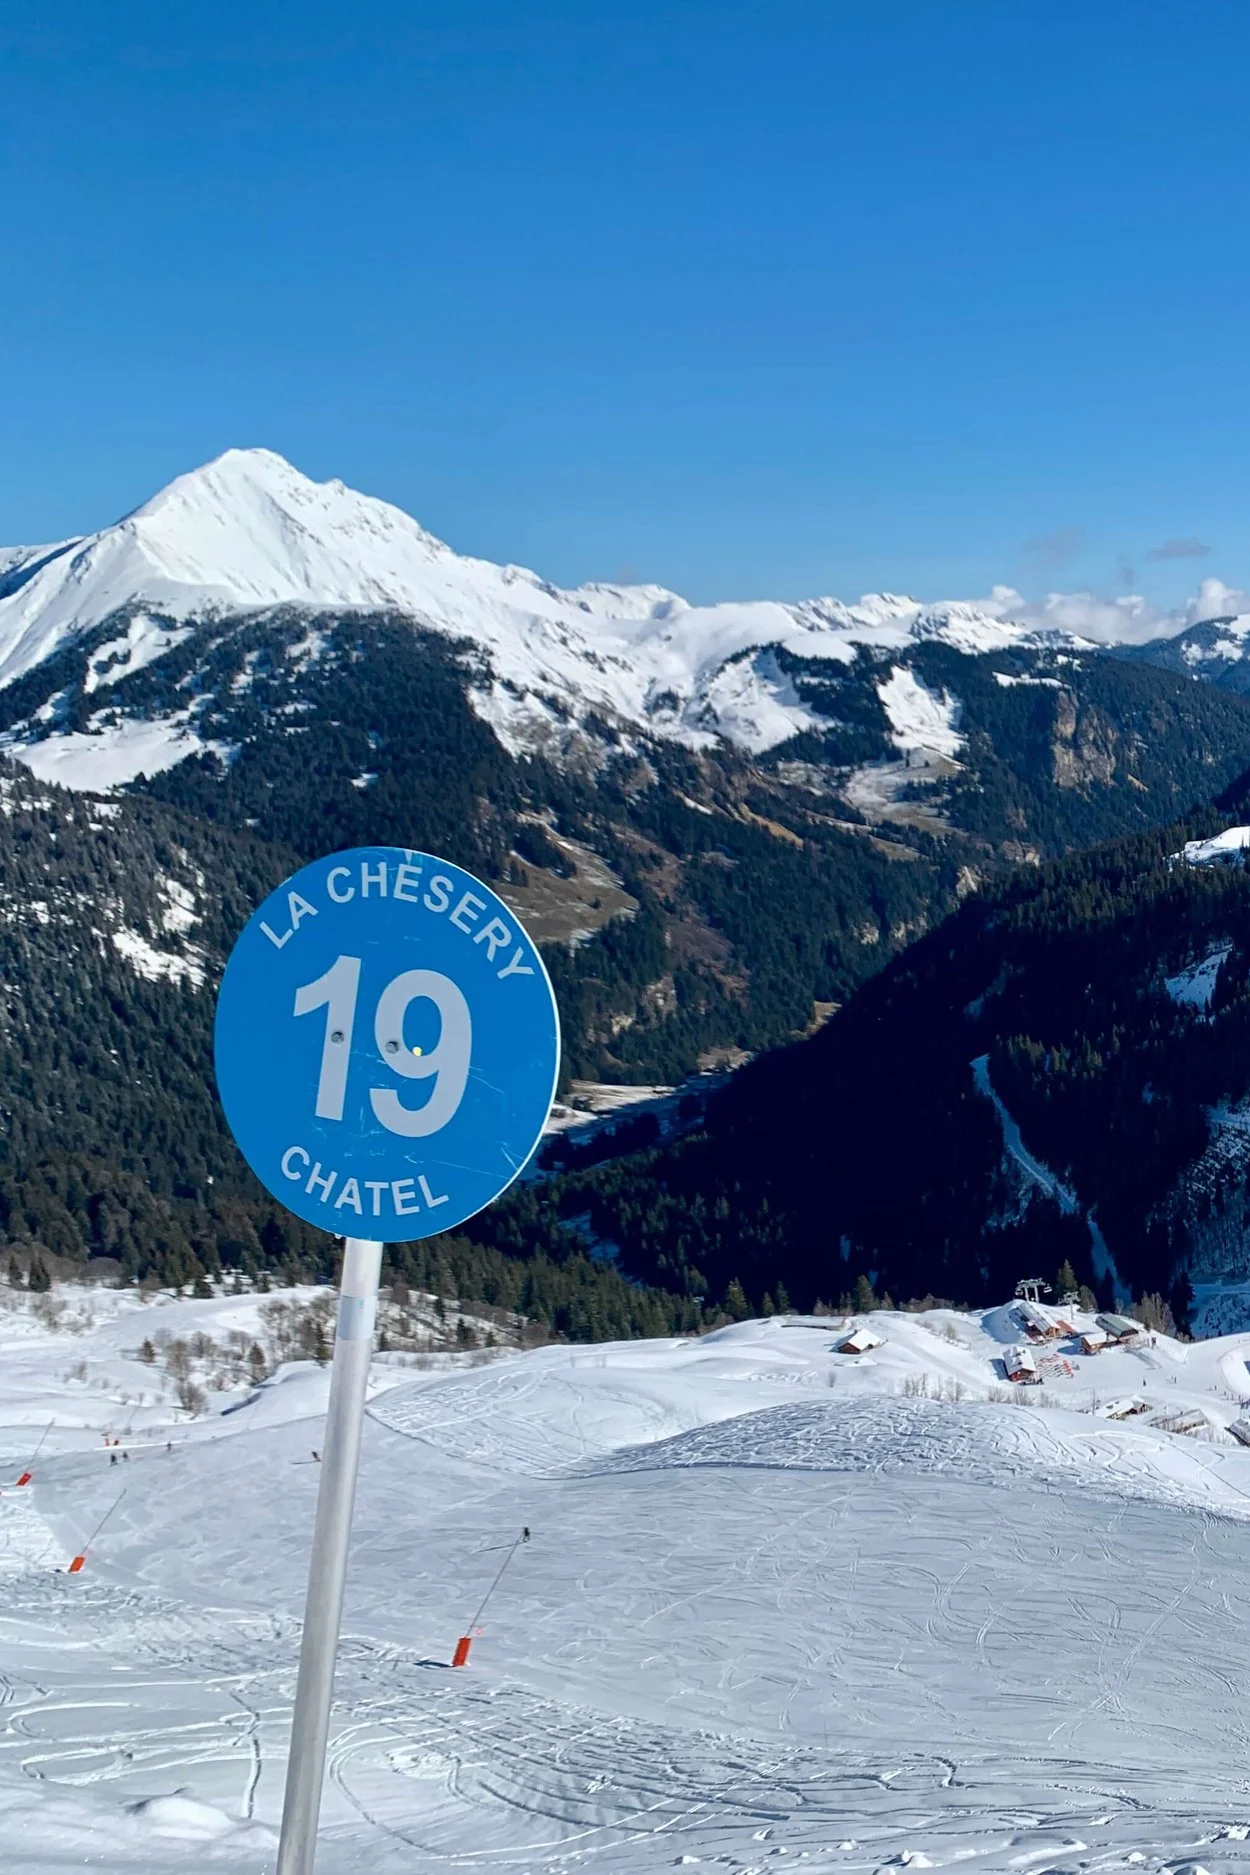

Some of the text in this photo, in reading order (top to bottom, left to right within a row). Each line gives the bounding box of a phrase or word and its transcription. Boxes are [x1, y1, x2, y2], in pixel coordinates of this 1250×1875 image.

[259, 862, 534, 980] LA CHESERY
[293, 954, 472, 1138] 19
[280, 1145, 449, 1216] CHATEL
